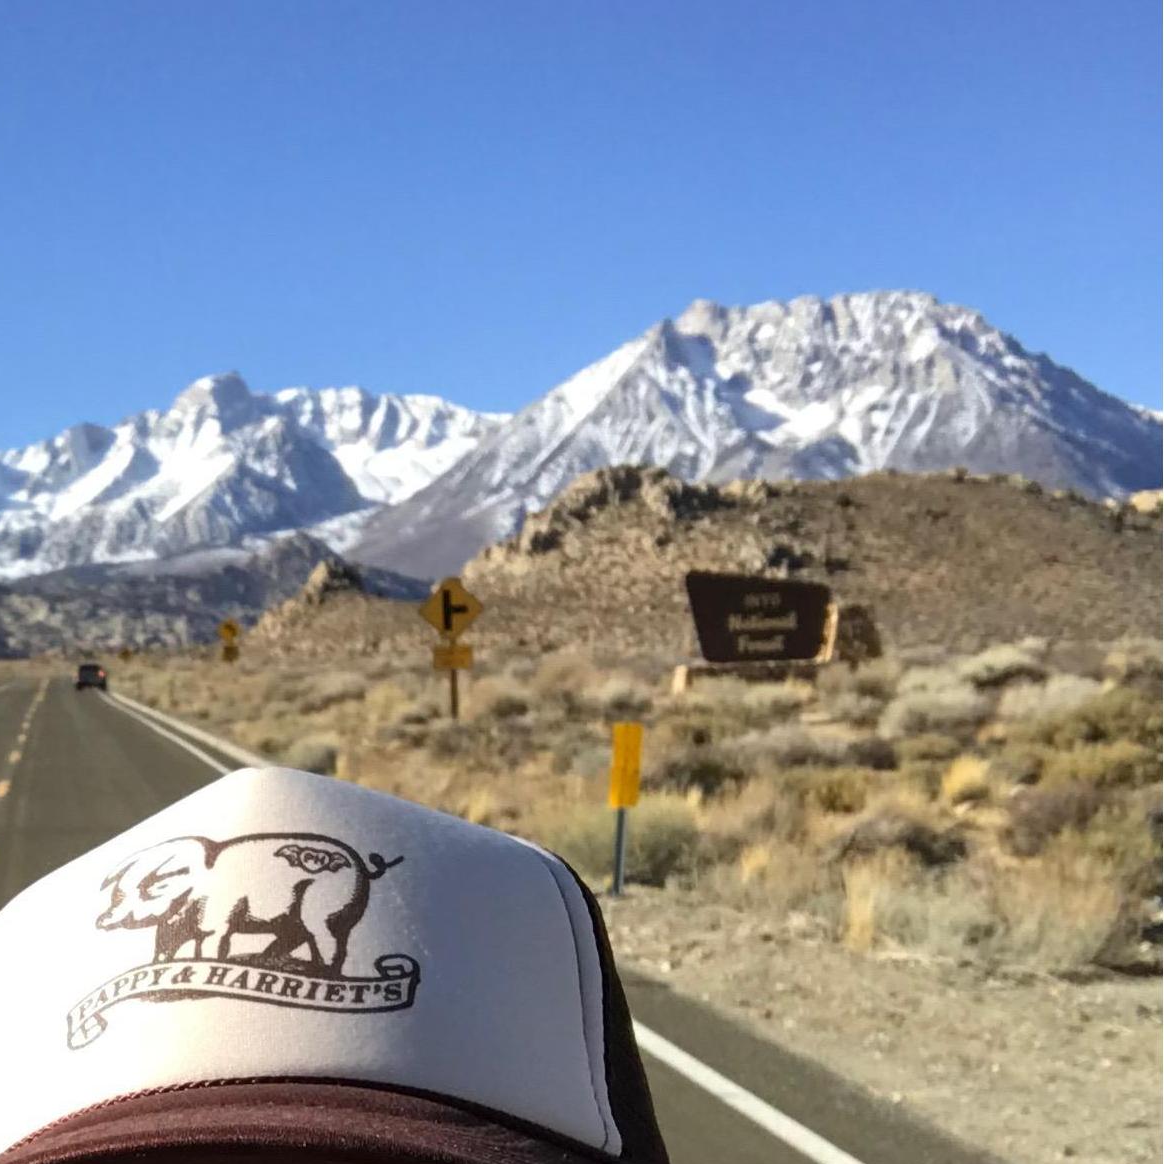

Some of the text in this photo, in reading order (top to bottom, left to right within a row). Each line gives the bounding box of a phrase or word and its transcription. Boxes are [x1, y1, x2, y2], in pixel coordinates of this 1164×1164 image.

[303, 852, 326, 866] PH
[78, 965, 403, 1021] PAPPY & HARRIET'S
